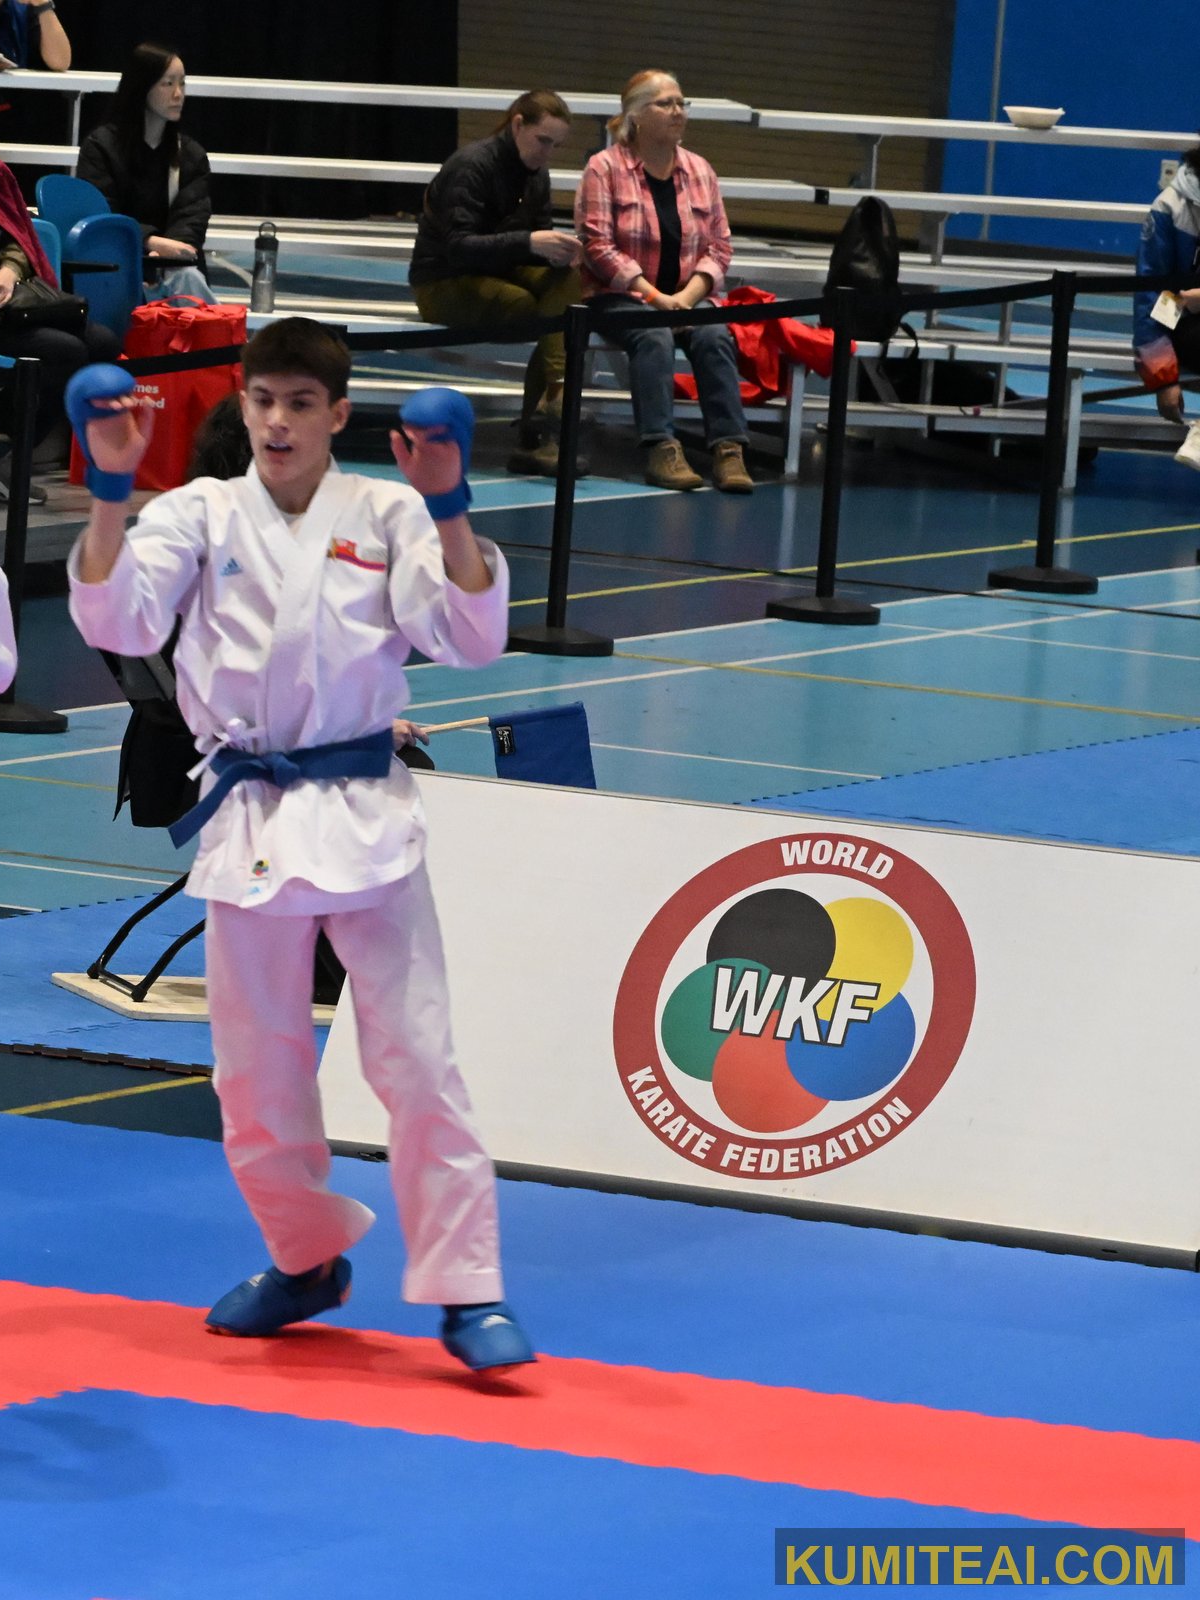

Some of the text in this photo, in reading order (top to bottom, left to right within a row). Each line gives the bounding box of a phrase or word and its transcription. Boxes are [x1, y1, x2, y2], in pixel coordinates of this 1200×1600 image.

[780, 839, 894, 880] WORLD
[709, 964, 882, 1048] WKF
[627, 1065, 913, 1174] KARATE FEDERATION
